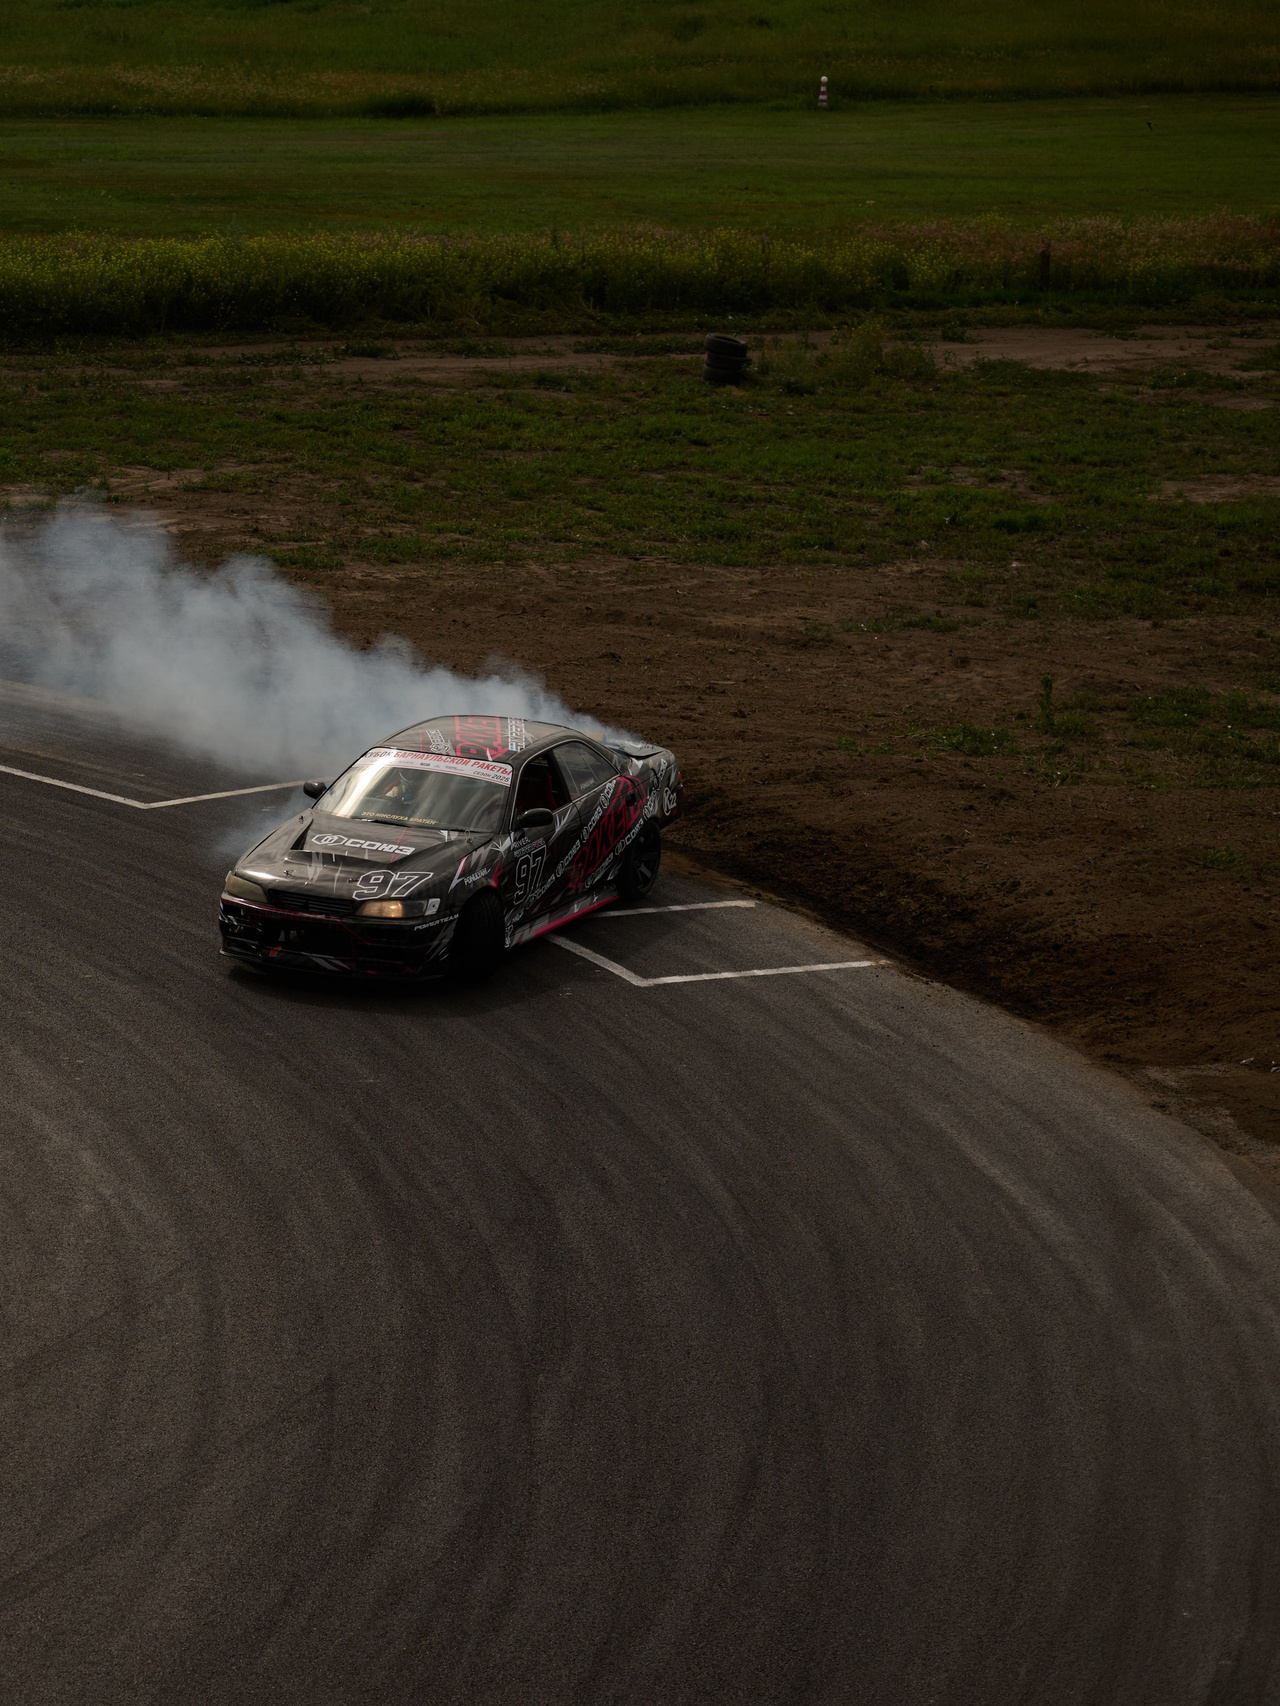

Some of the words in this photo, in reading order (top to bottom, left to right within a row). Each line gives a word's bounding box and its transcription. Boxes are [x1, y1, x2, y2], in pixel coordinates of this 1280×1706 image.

[393, 751, 470, 767] БАРНАУЛЬСКОЙ
[471, 761, 513, 776] РАКЕТЫ
[491, 773, 510, 783] 2025
[344, 838, 415, 856] СОЮЗ
[352, 869, 434, 901] 97
[513, 844, 547, 905] 97
